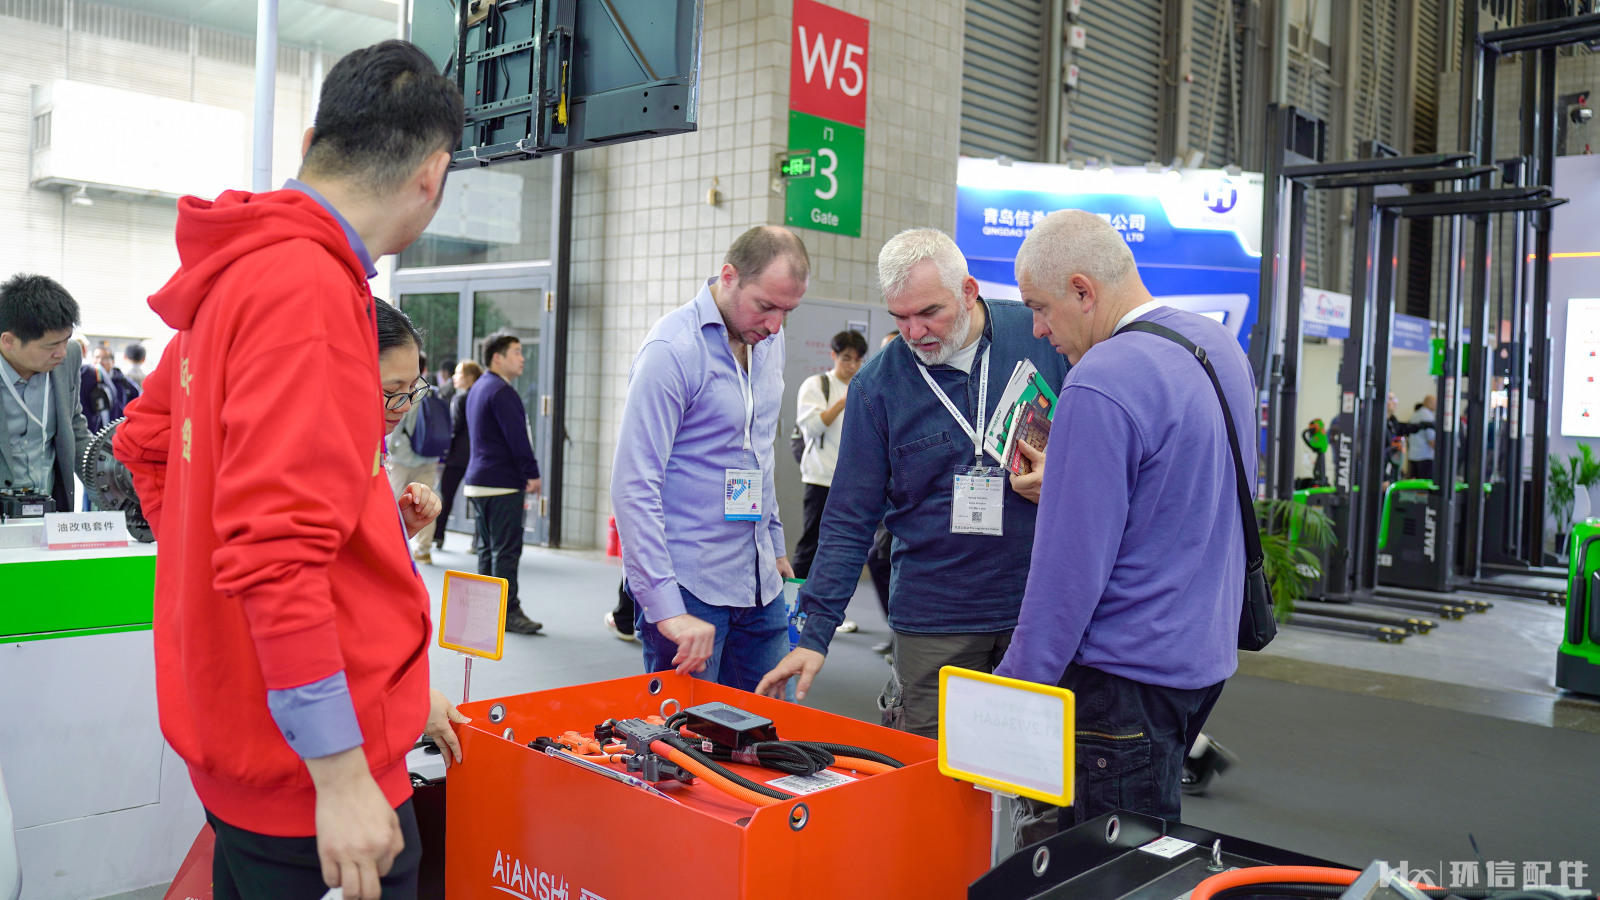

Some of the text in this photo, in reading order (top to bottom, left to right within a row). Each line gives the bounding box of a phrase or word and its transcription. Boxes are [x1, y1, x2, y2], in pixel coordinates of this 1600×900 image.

[798, 26, 864, 97] W5
[823, 126, 834, 142] 门
[815, 148, 838, 200] 3
[811, 207, 839, 227] Gate
[982, 225, 1024, 238] QINGDAO
[1126, 232, 1145, 242] LTD
[1338, 433, 1352, 493] JIALIFT
[57, 520, 114, 533] 油改电套件
[1423, 506, 1437, 562] JIALIFT
